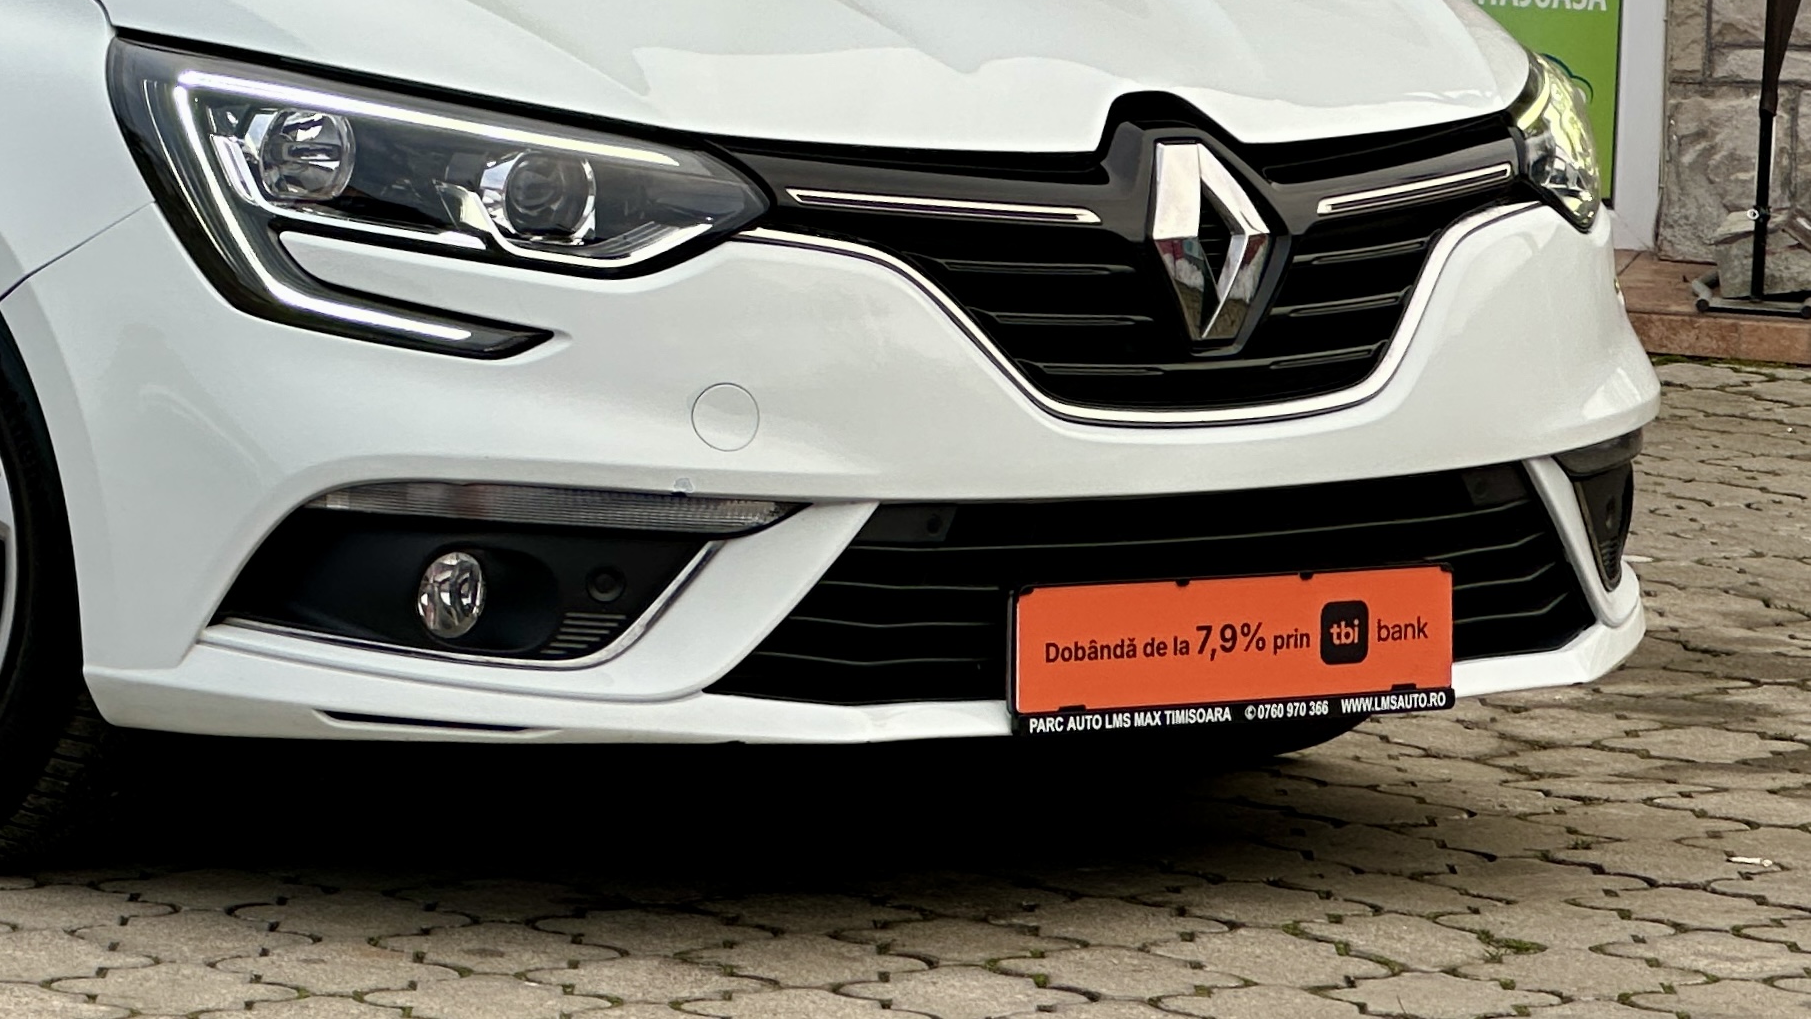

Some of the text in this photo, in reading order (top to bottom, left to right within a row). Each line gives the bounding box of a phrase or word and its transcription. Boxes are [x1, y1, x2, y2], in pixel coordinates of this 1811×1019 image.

[1045, 616, 1428, 663] Dobândă de la 7,9% prin tbi bank
[1029, 718, 1065, 733] PARC
[1066, 715, 1102, 732] AUTO
[1104, 714, 1132, 729] LMS
[1134, 712, 1162, 728] MAX
[1164, 707, 1232, 726] TIMISOARA
[1286, 703, 1306, 718] 970
[1308, 701, 1329, 717] 366
[1341, 692, 1446, 715] WWW.LMSAUTO.RO
